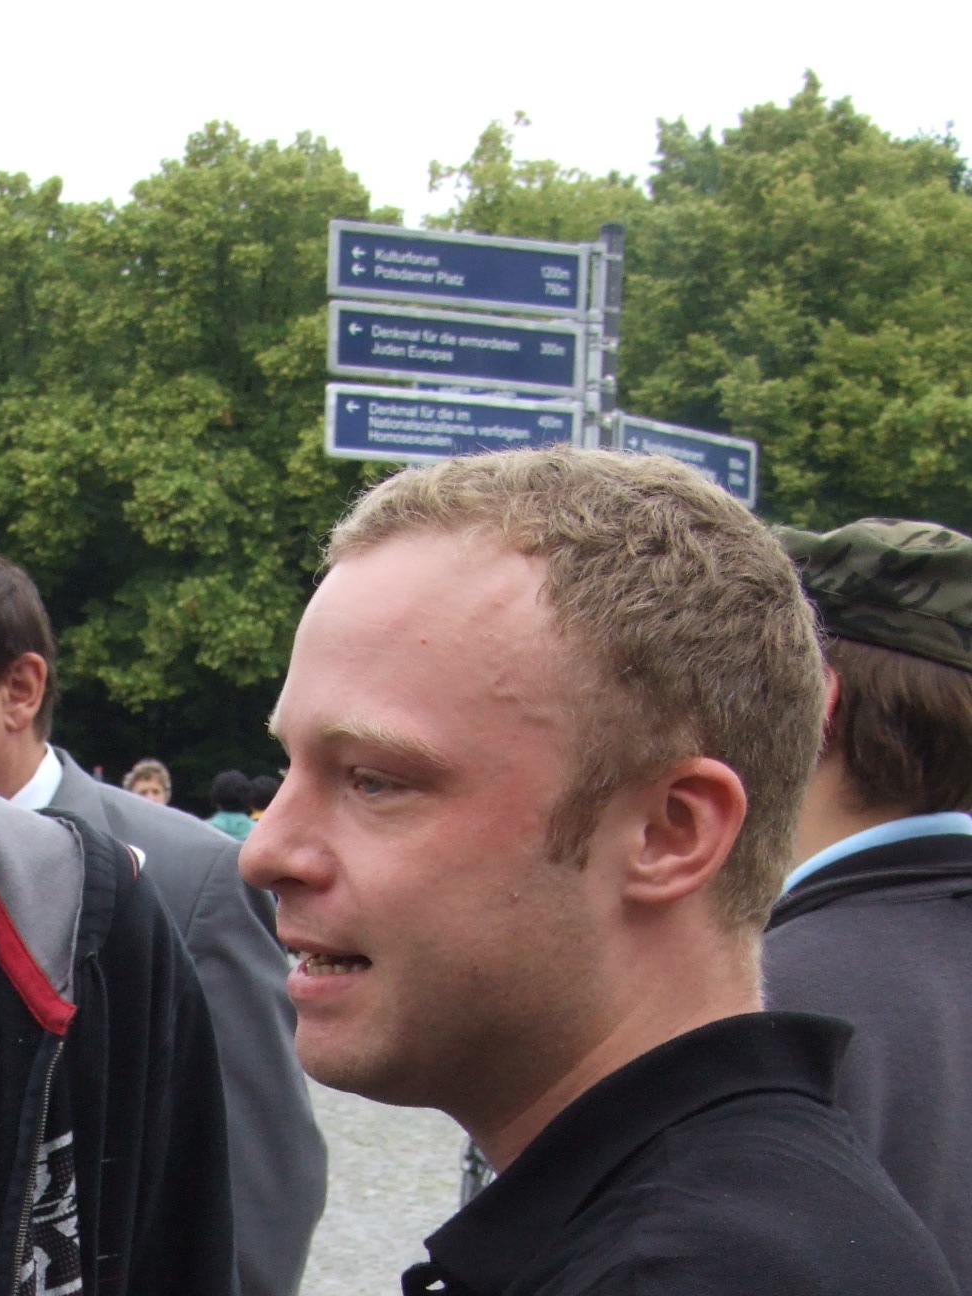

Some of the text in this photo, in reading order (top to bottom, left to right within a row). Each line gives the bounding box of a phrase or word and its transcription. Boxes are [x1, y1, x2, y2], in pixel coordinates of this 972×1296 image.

[374, 249, 439, 266] Kulturforum
[374, 265, 465, 287] Potsdamer Platz
[371, 324, 520, 351] Denkmal für die ermordeten
[371, 342, 453, 363] Juden Europas
[368, 402, 470, 421] Denkmal für die im
[368, 416, 475, 436] Nationalsozialismus
[368, 432, 452, 448] Homosexuellen
